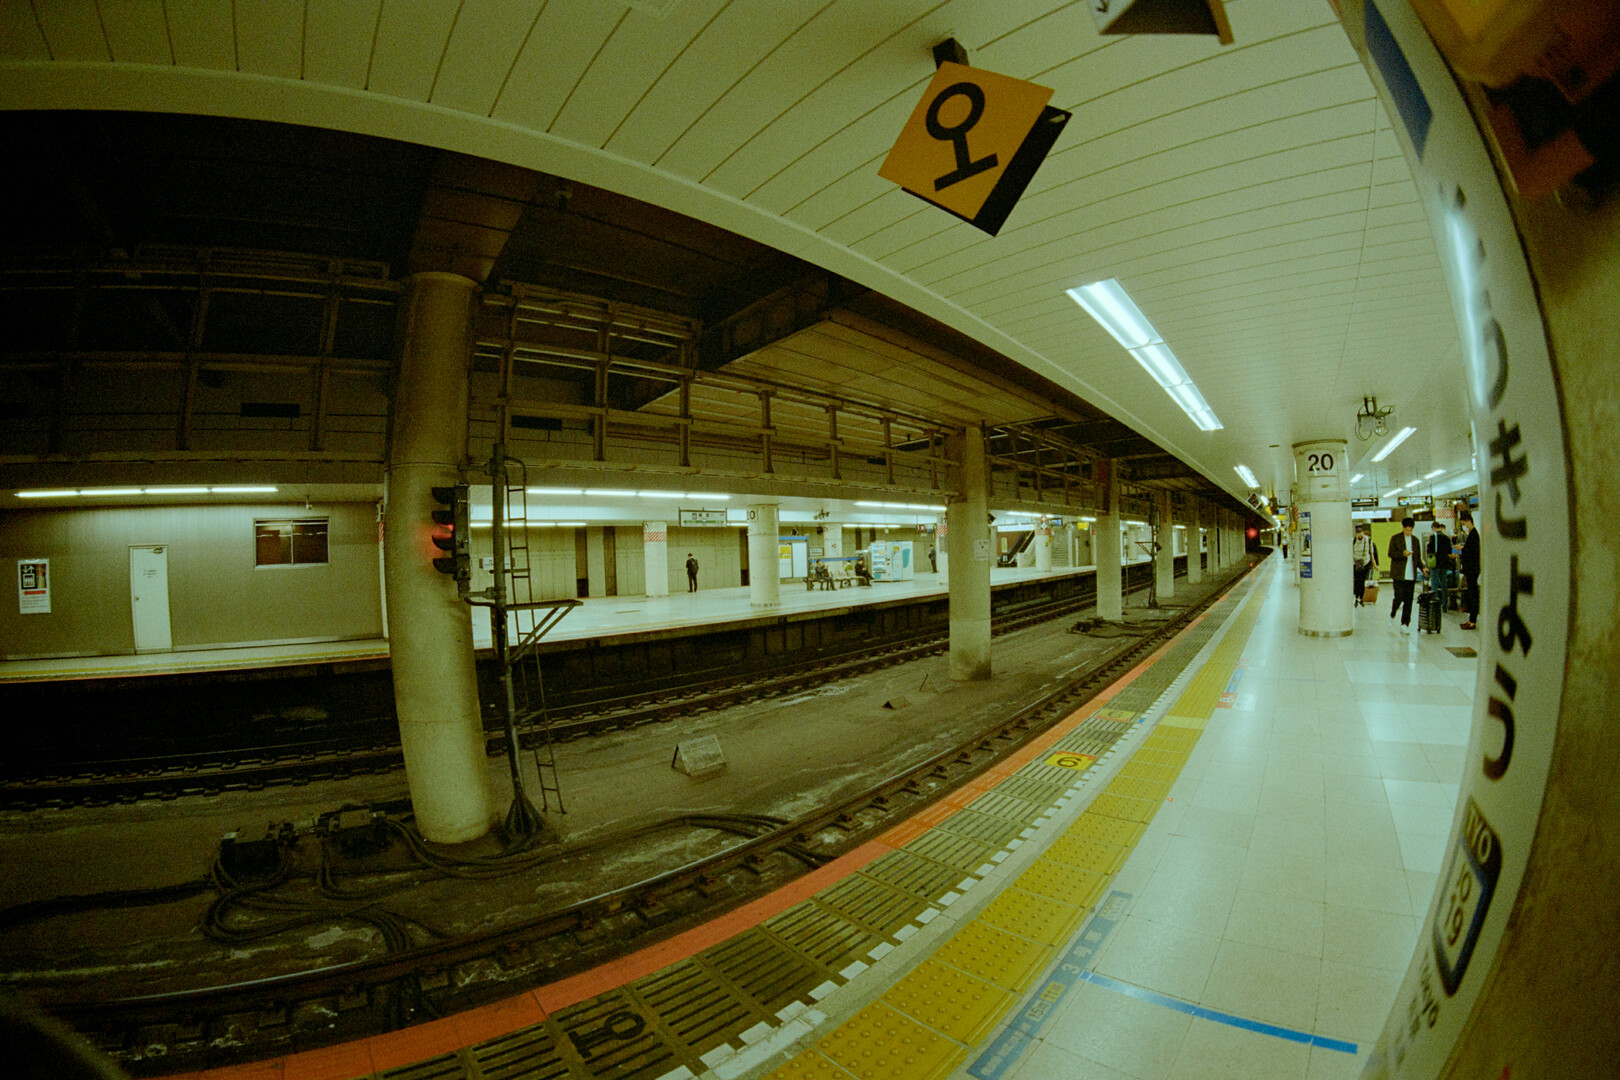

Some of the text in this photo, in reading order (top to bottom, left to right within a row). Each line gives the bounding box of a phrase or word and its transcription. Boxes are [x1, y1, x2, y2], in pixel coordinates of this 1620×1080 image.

[1307, 453, 1334, 472] 20
[1466, 807, 1492, 864] TYO
[1444, 893, 1464, 947] 19
